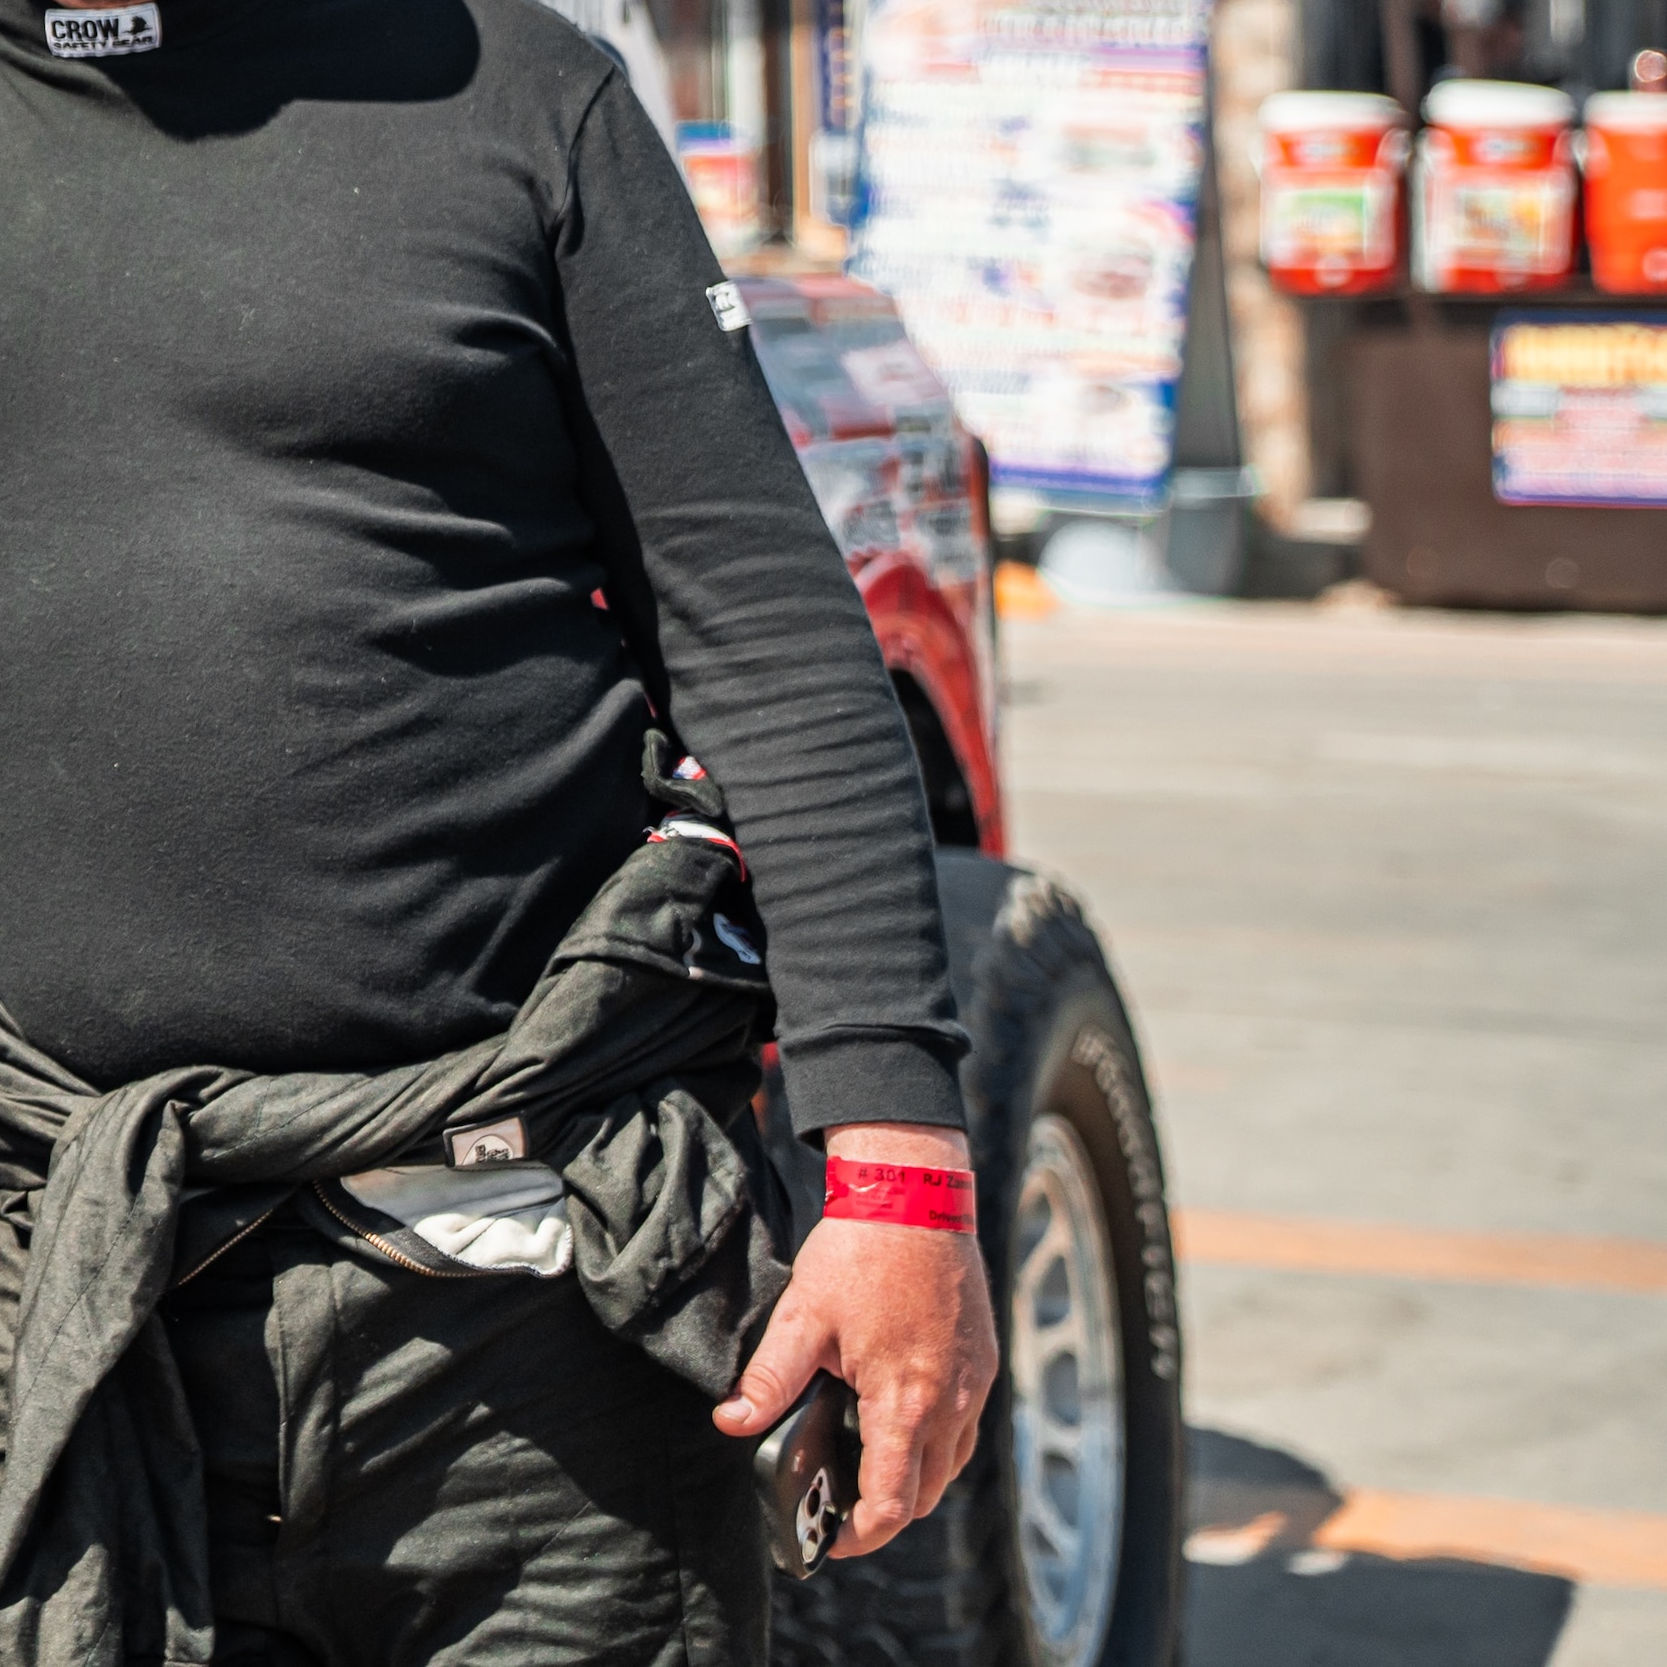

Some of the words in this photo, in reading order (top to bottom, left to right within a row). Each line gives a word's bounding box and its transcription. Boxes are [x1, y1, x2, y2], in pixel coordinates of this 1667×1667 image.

[51, 17, 119, 40] CROW
[53, 40, 107, 51] SAFETY
[874, 1168, 906, 1183] 301
[923, 1172, 943, 1187] RJ
